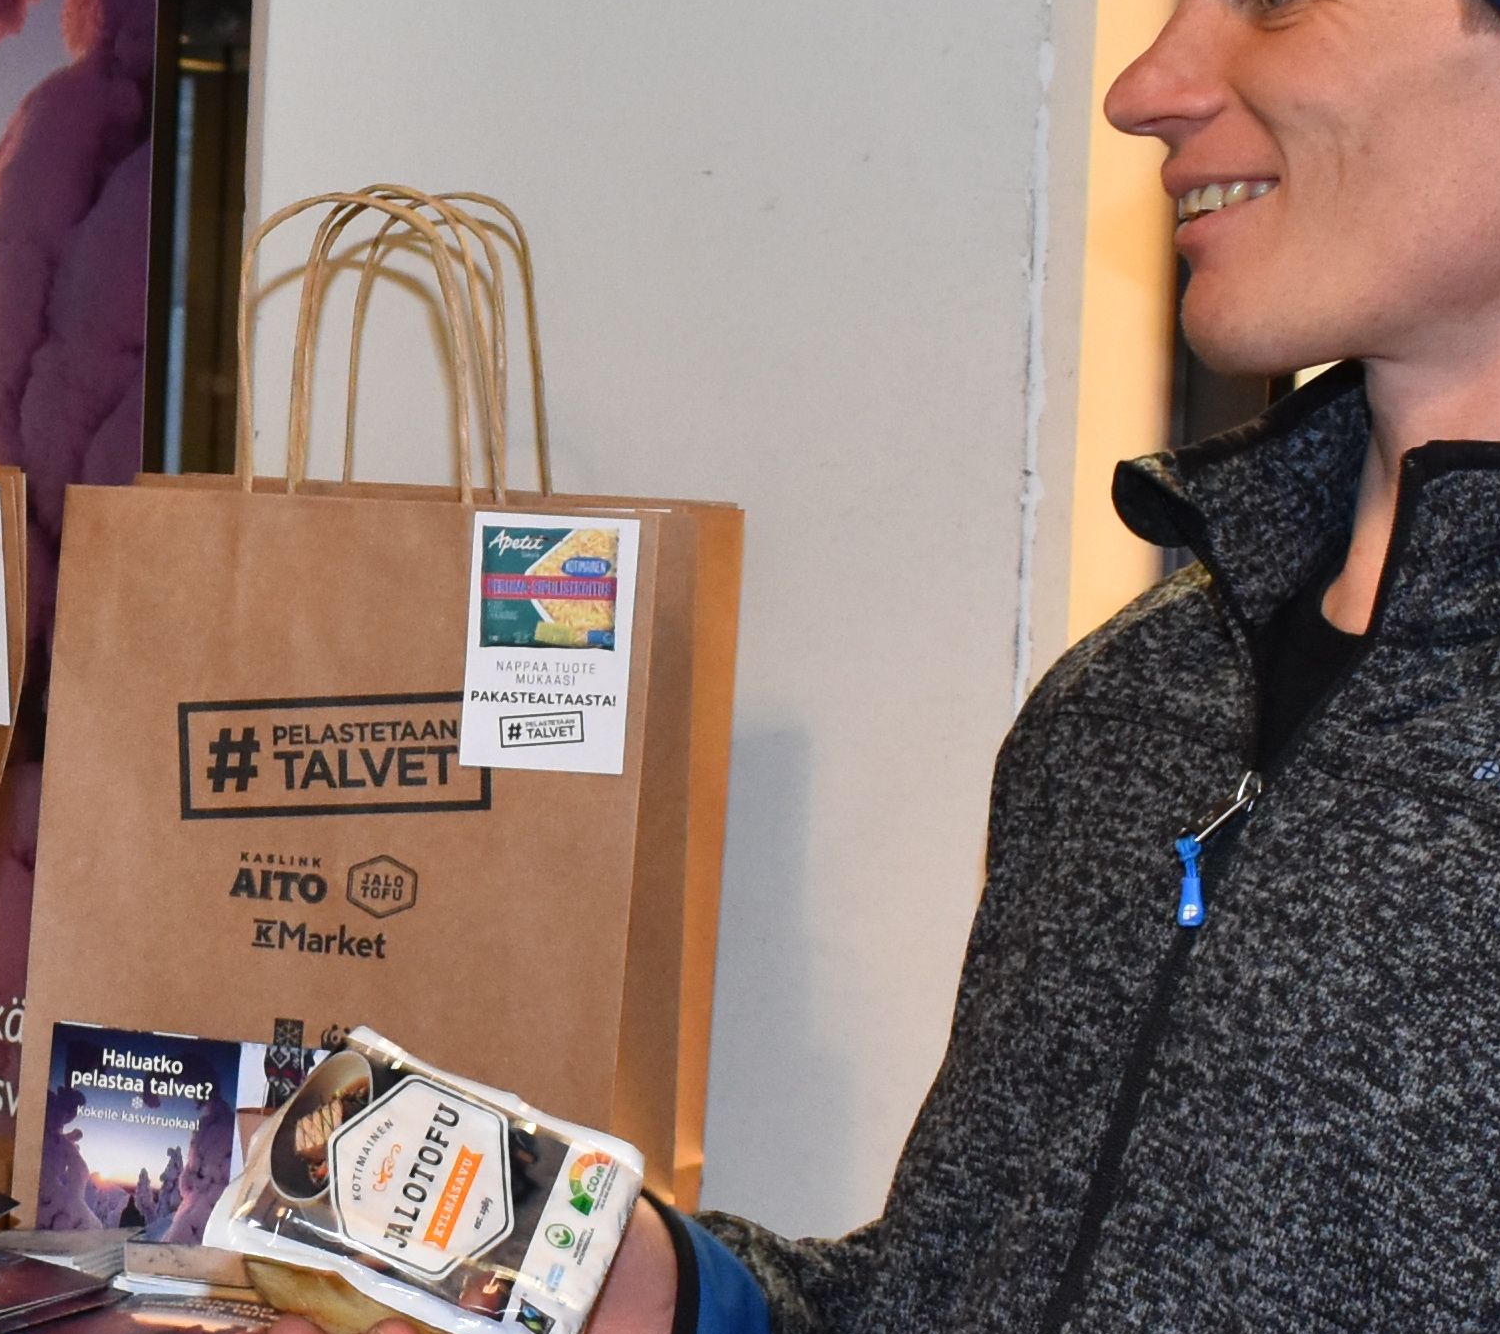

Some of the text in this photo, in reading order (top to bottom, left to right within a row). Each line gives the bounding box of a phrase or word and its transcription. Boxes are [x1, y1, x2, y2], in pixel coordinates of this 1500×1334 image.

[489, 529, 544, 556] Apetit
[496, 660, 596, 675] NAPPAA TUOTE
[516, 673, 576, 686] MUKAASI
[470, 690, 617, 707] PAKASTEALTAASTA!
[272, 720, 458, 746] PELASTETAAN
[526, 725, 575, 740] TALVET
[273, 746, 458, 790] TALVET
[241, 852, 321, 868] KASLINK
[229, 868, 328, 904] AITO
[360, 886, 403, 901] TOFU
[361, 873, 403, 888] JALO
[102, 1048, 183, 1075] Haluatko
[71, 1069, 213, 1100] pelastaa talvet?
[76, 1104, 200, 1131] Kokeile kasvisruokaa!
[352, 1119, 394, 1201] KOTIMAINEN
[383, 1102, 460, 1248] JALOTOFU
[433, 1157, 473, 1238] KYLMÄSAVU
